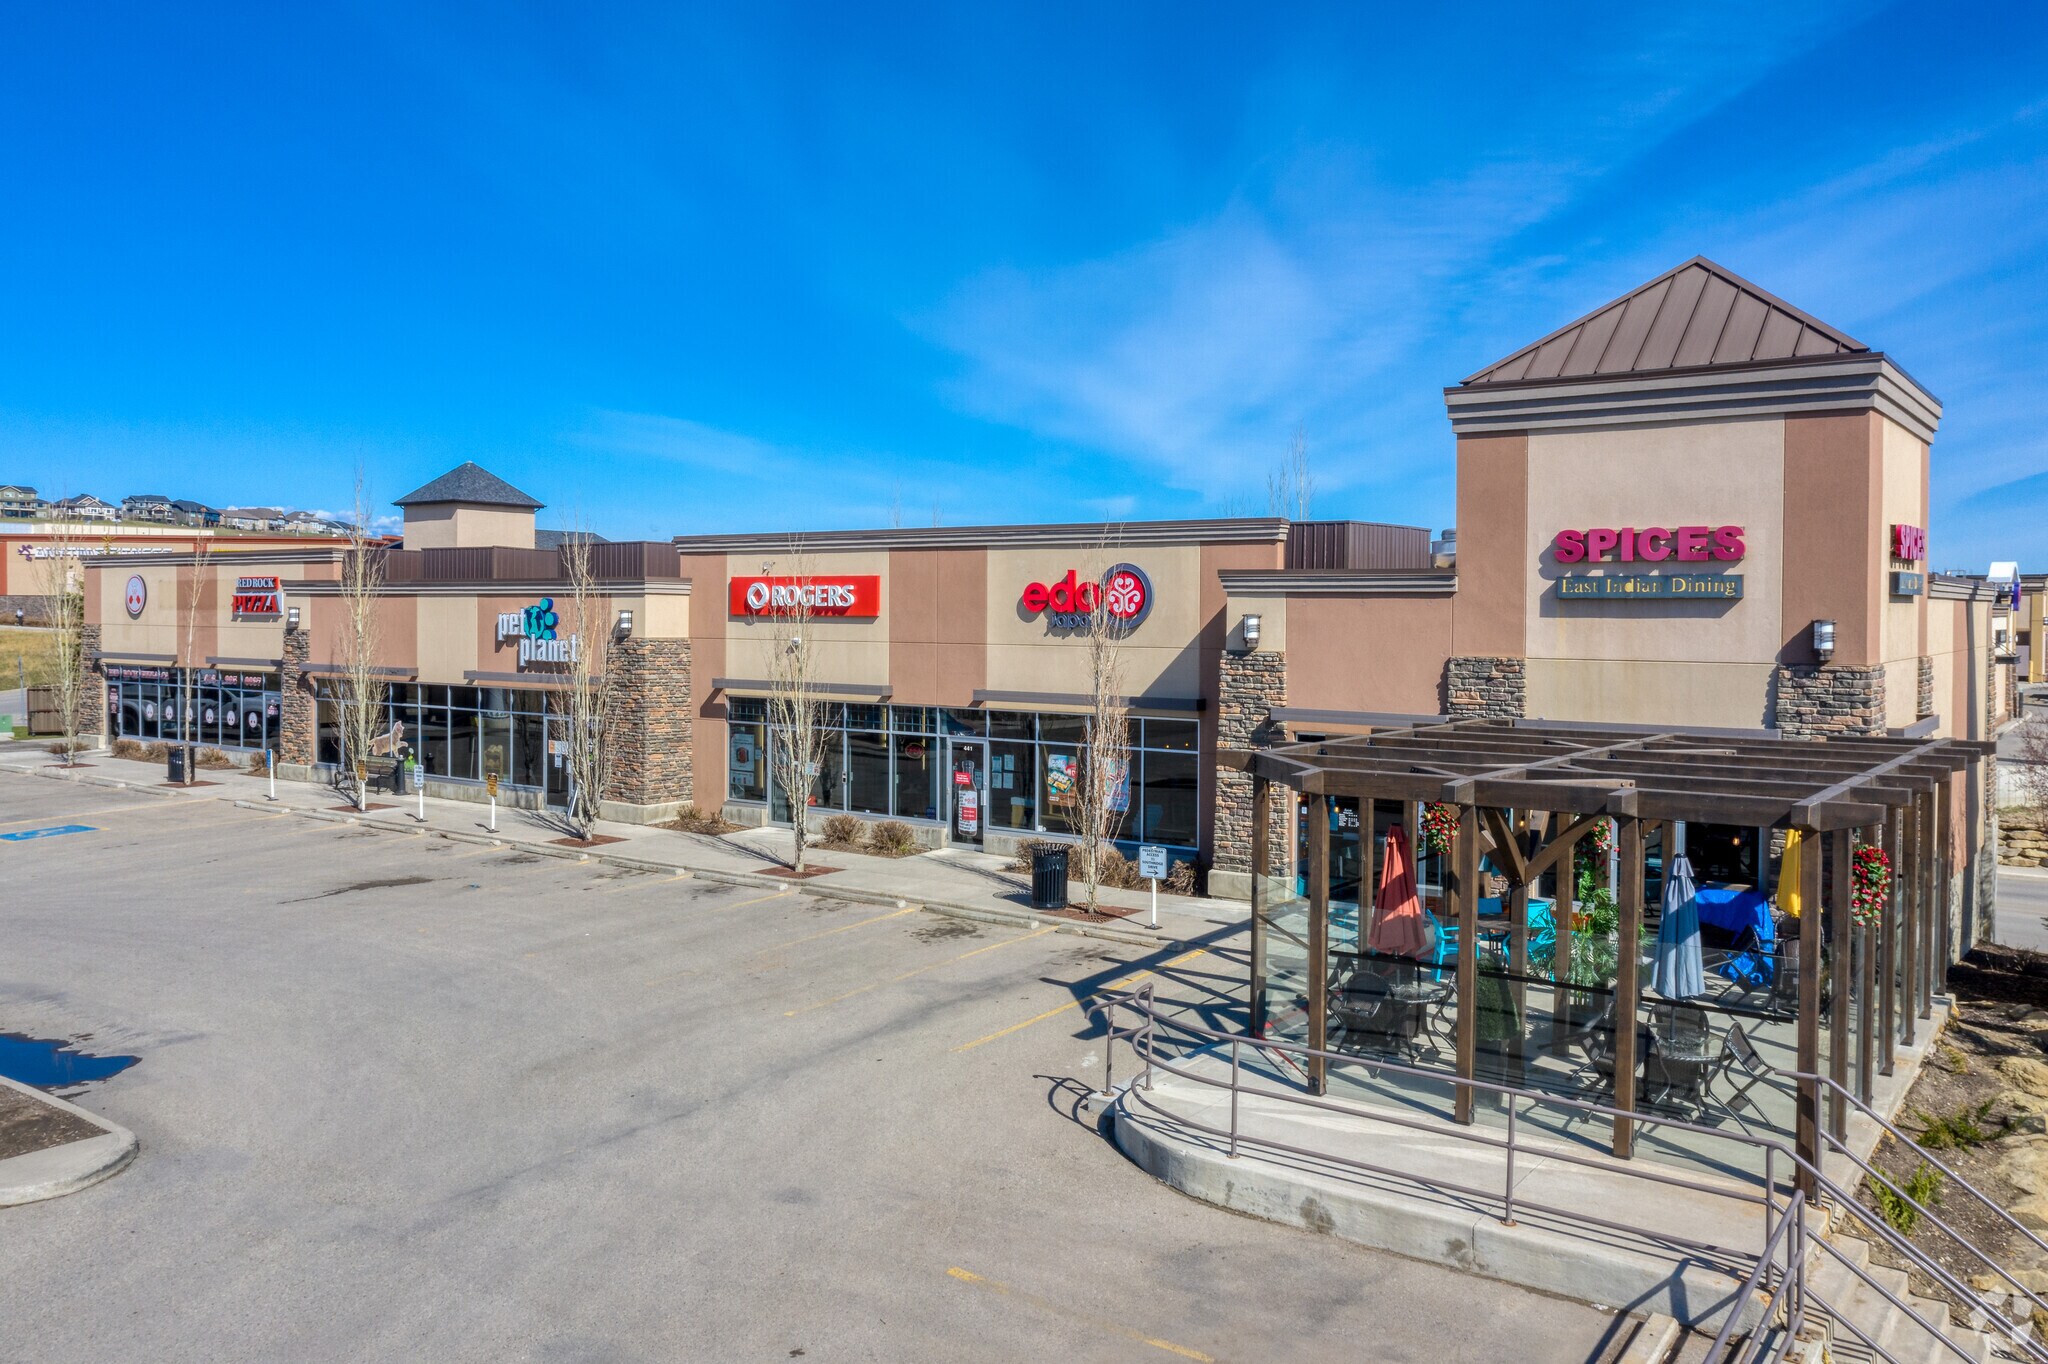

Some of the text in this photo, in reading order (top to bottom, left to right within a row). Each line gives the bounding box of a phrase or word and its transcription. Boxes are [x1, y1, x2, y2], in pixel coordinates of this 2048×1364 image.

[1553, 525, 1746, 563] SPICES
[771, 584, 855, 607] ROGERS
[1023, 569, 1102, 613] edo
[1562, 579, 1599, 593] East
[1672, 577, 1736, 596] Dining
[232, 595, 278, 613] PIZZA
[498, 607, 527, 641] pet
[519, 633, 578, 667] planet
